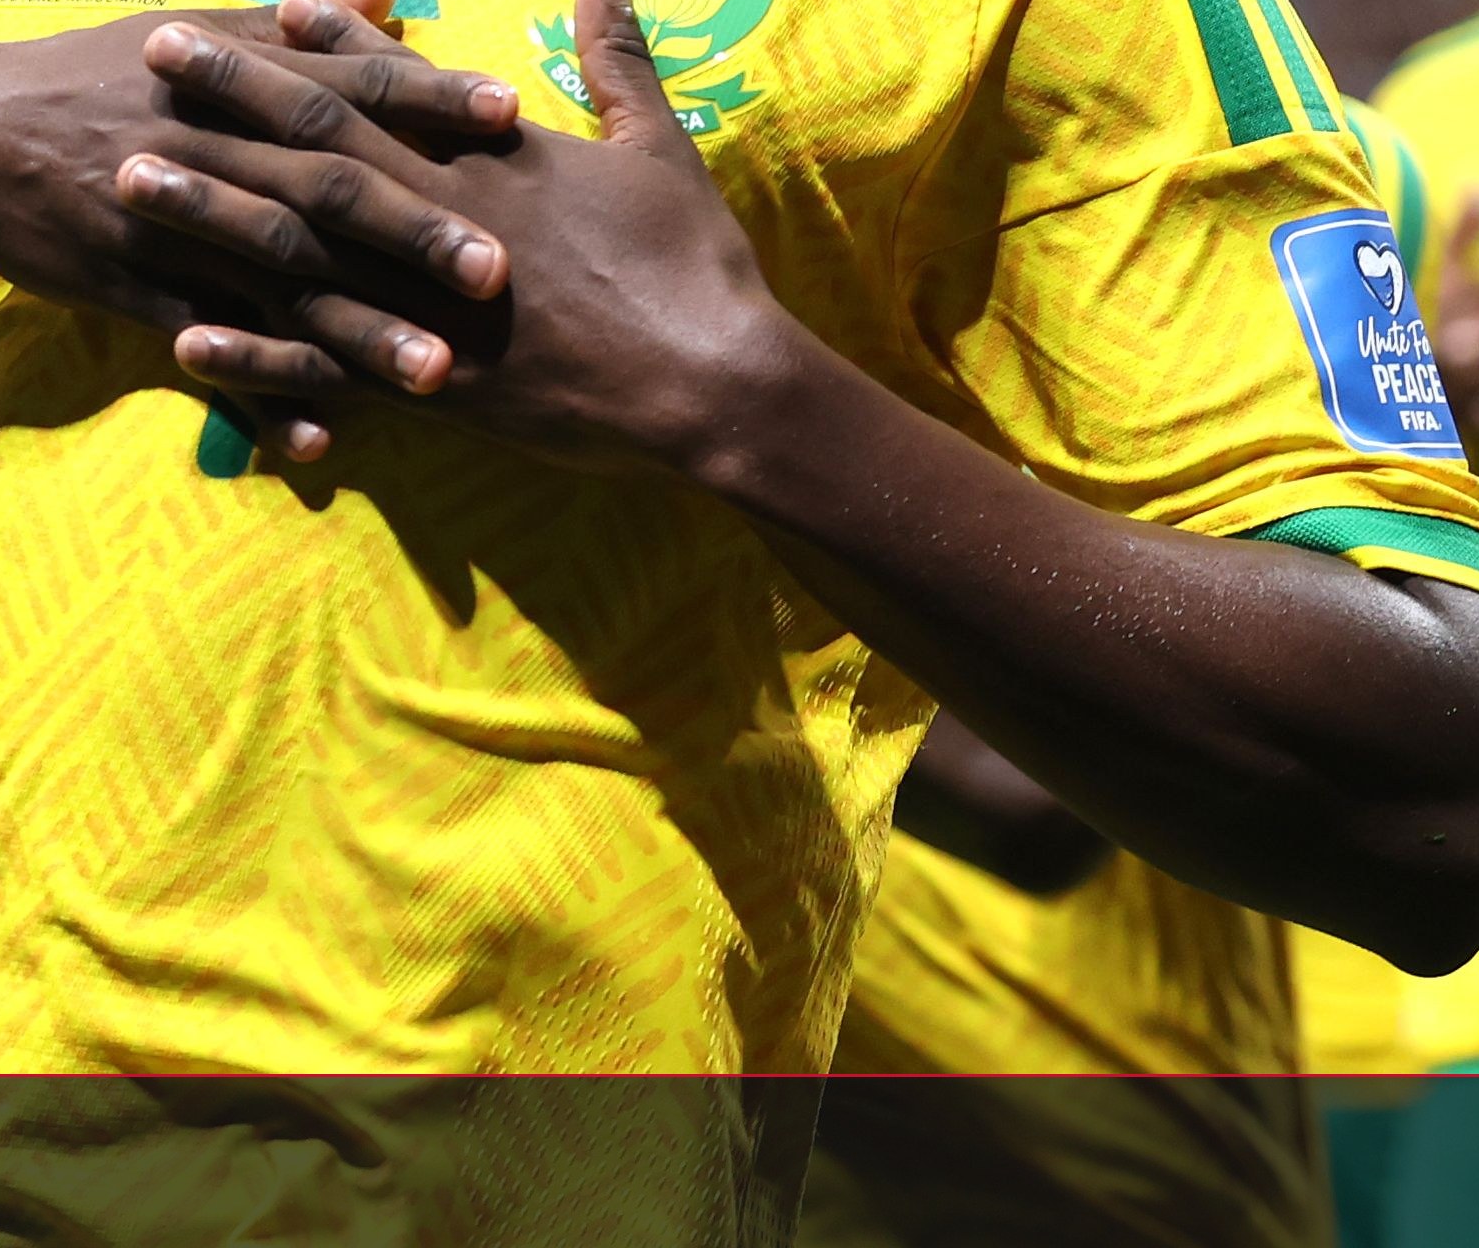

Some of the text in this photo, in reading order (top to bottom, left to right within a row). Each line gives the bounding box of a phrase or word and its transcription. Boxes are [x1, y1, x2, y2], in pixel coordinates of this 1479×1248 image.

[550, 62, 594, 109] SOU
[1357, 315, 1433, 364] Unite Fo
[1371, 363, 1448, 404] PEACE
[1399, 410, 1440, 431] FIFA
